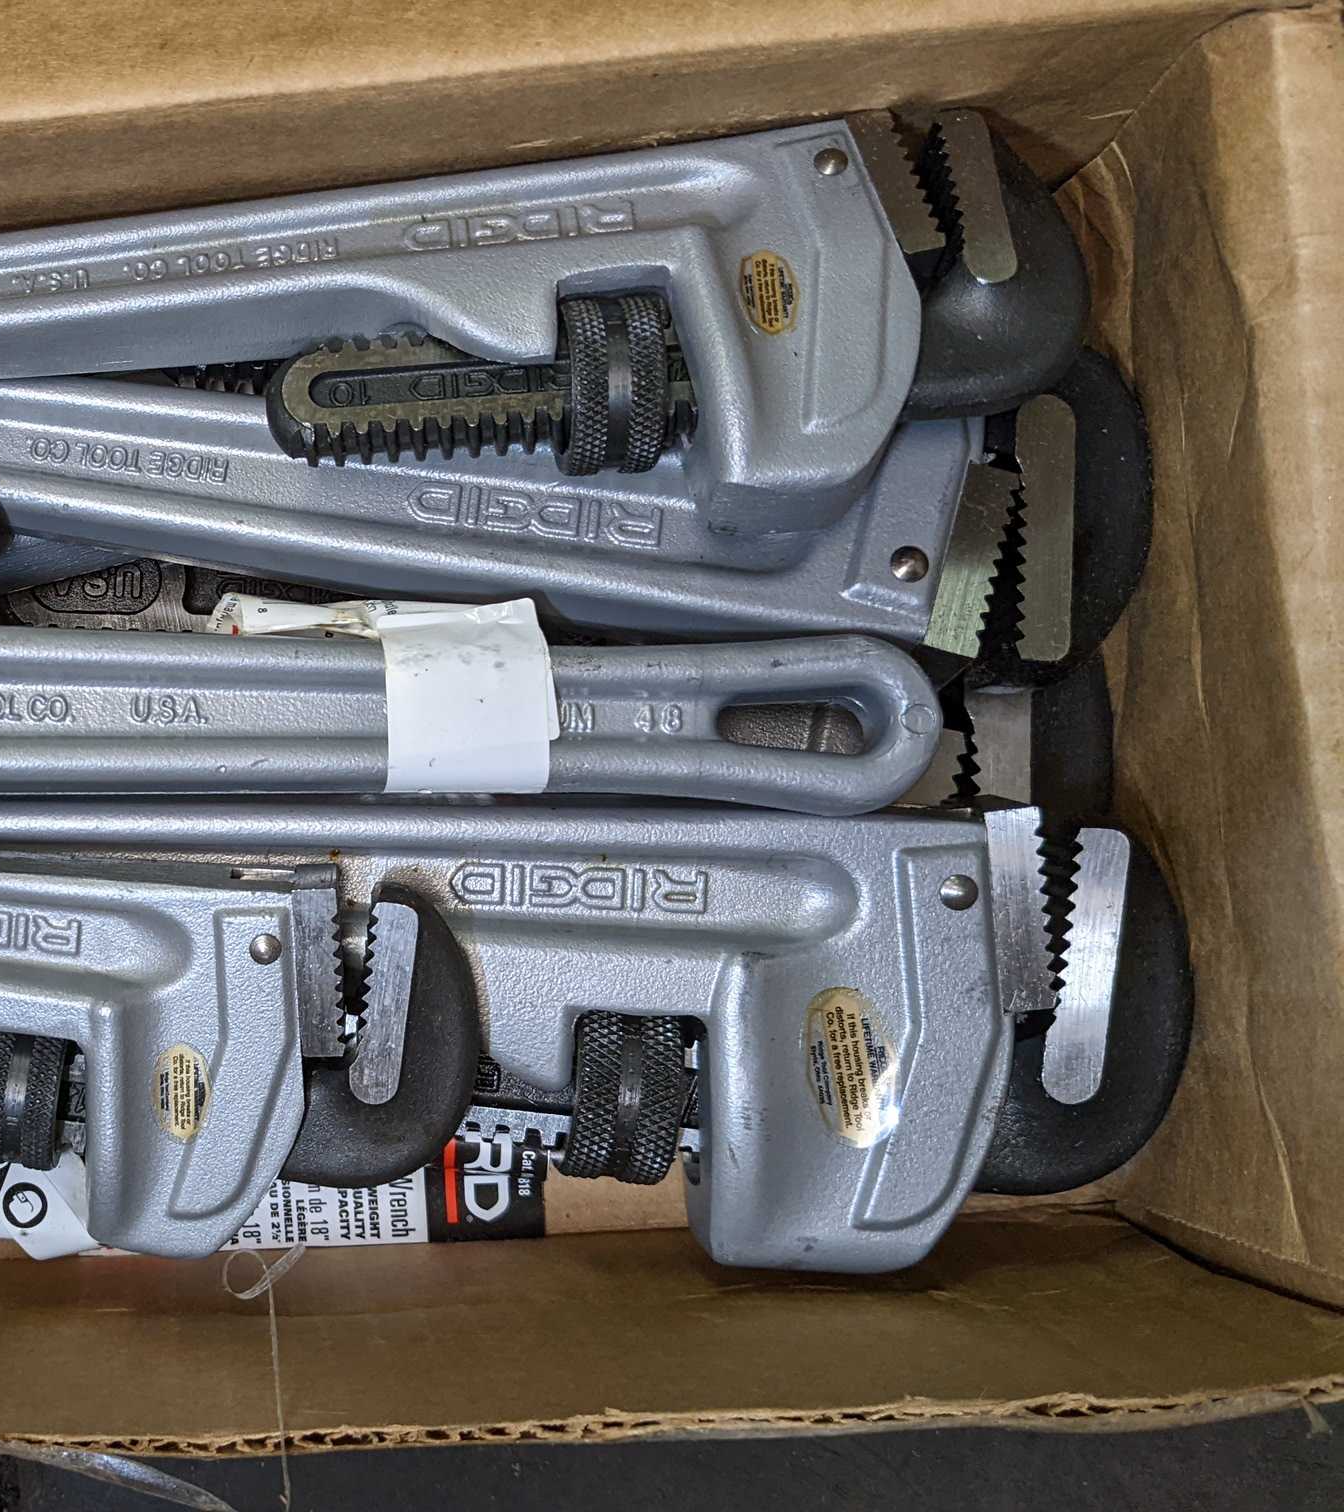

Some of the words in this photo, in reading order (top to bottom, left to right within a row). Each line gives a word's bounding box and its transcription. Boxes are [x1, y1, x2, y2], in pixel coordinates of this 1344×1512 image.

[403, 199, 637, 251] RIDGID
[182, 249, 248, 276] TOOL
[255, 236, 341, 268] RIDGE
[76, 442, 143, 474] TOOL
[151, 451, 229, 485] RIDGE
[407, 481, 663, 551] RIDGID
[449, 861, 707, 914] RIDGID
[846, 1073, 854, 1082] to
[270, 1203, 279, 1218] DE
[296, 1199, 309, 1242] LÉGÈRE
[309, 1198, 327, 1213] de
[353, 1188, 365, 1239] UALITY
[310, 1219, 330, 1240] 18"
